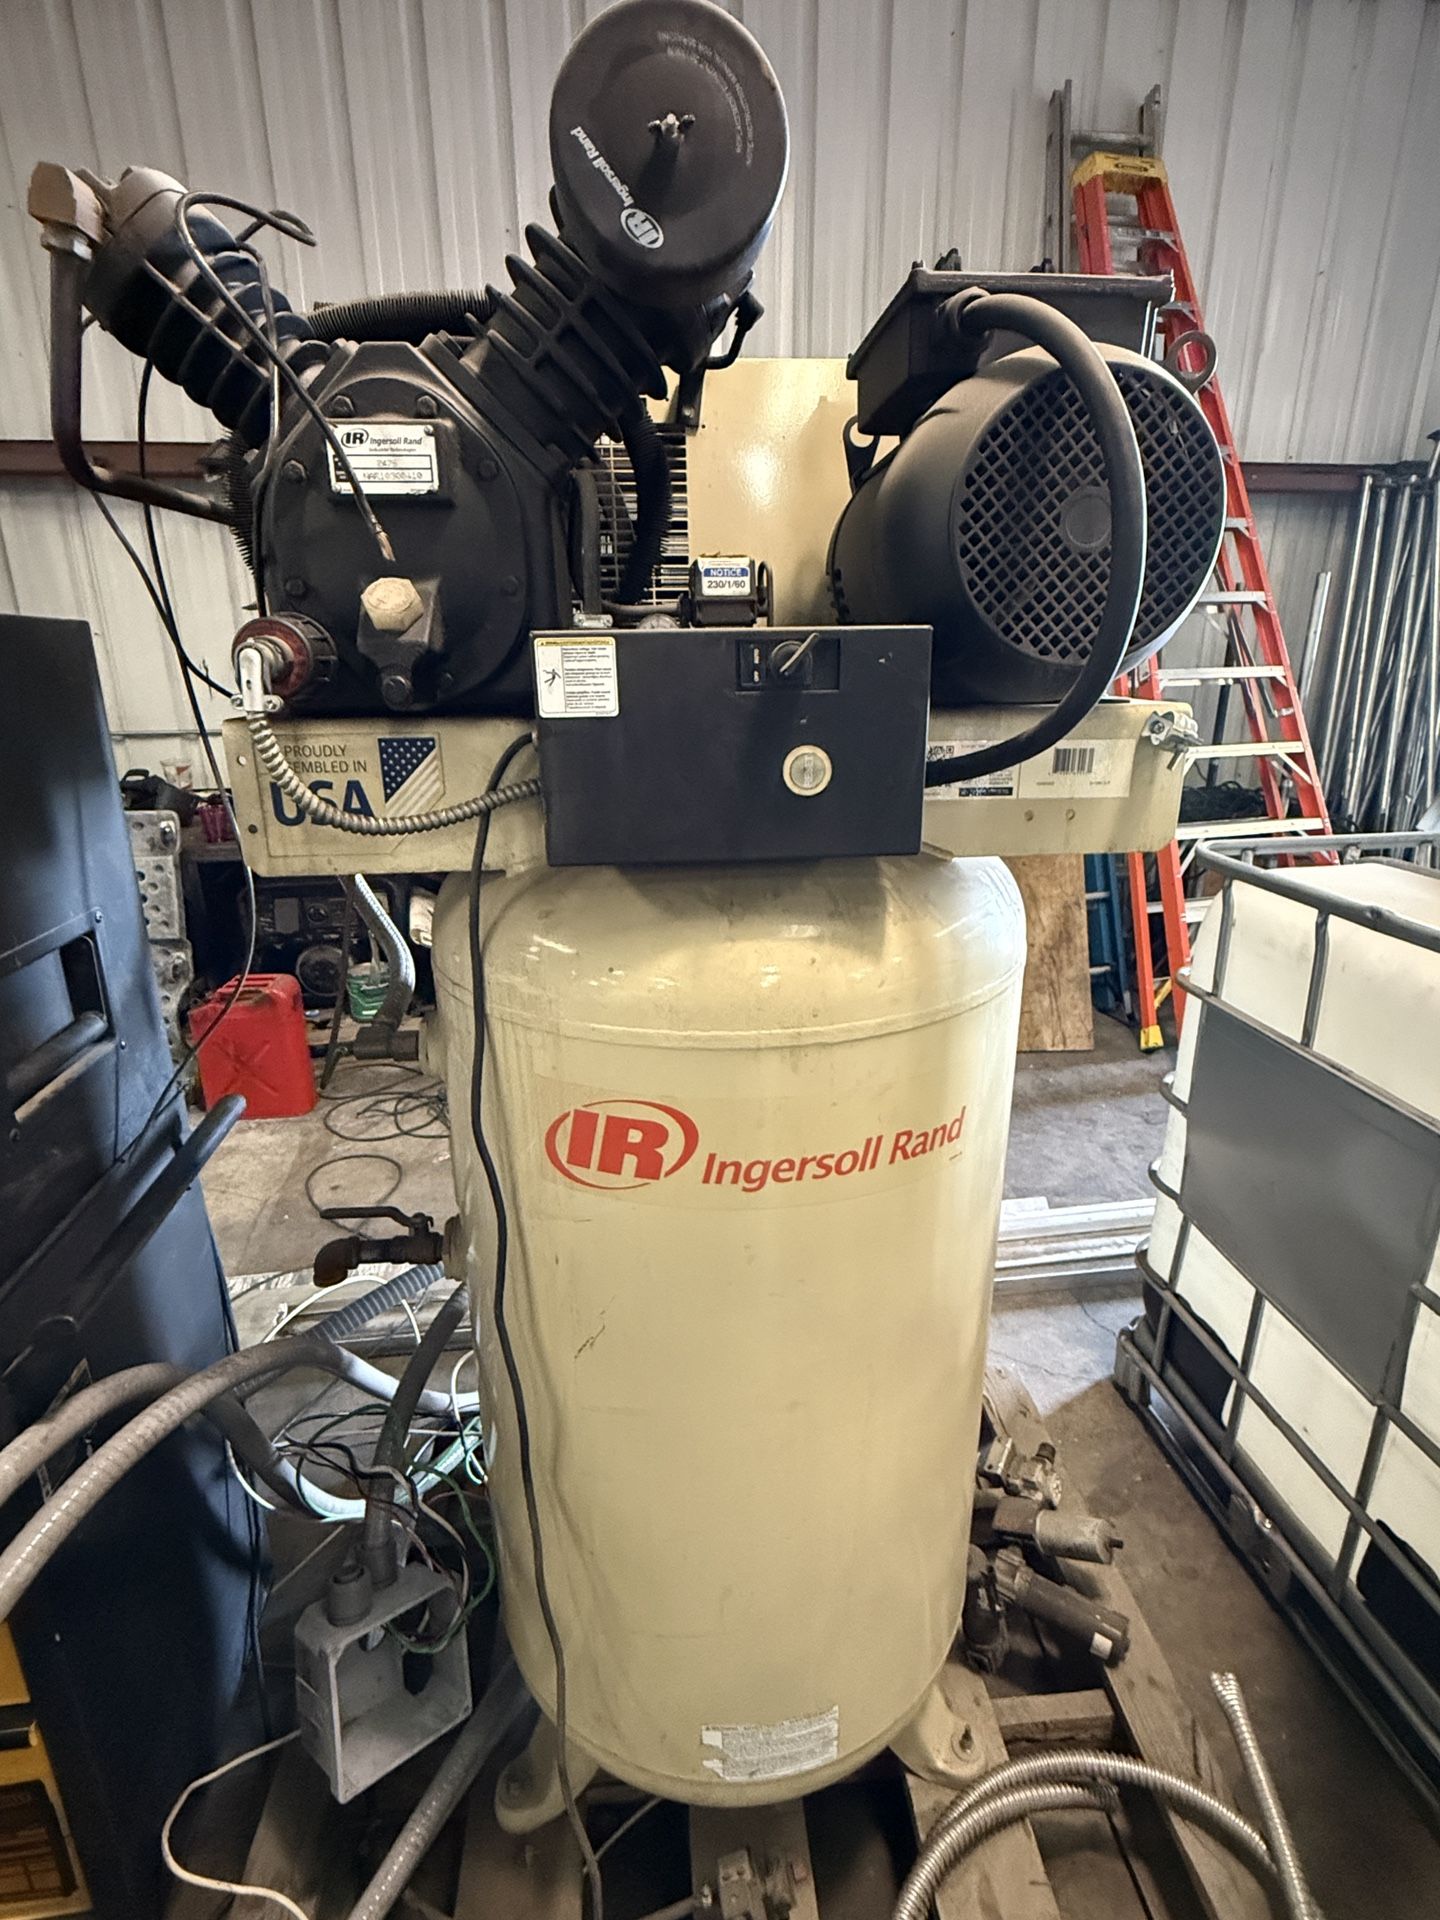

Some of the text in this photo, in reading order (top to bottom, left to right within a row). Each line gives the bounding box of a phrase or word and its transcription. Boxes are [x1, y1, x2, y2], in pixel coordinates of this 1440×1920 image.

[570, 126, 600, 159] Rand
[592, 156, 635, 207] Ingersoll
[370, 437, 402, 447] Ingersoll
[403, 437, 423, 445] Rand
[710, 569, 742, 577] NOTICE
[707, 580, 746, 589] 230/1/60
[284, 744, 347, 757] PROUDLY
[352, 760, 368, 772] IN
[269, 780, 376, 826] USA
[566, 1105, 966, 1192] IR Ingersoll Rand
